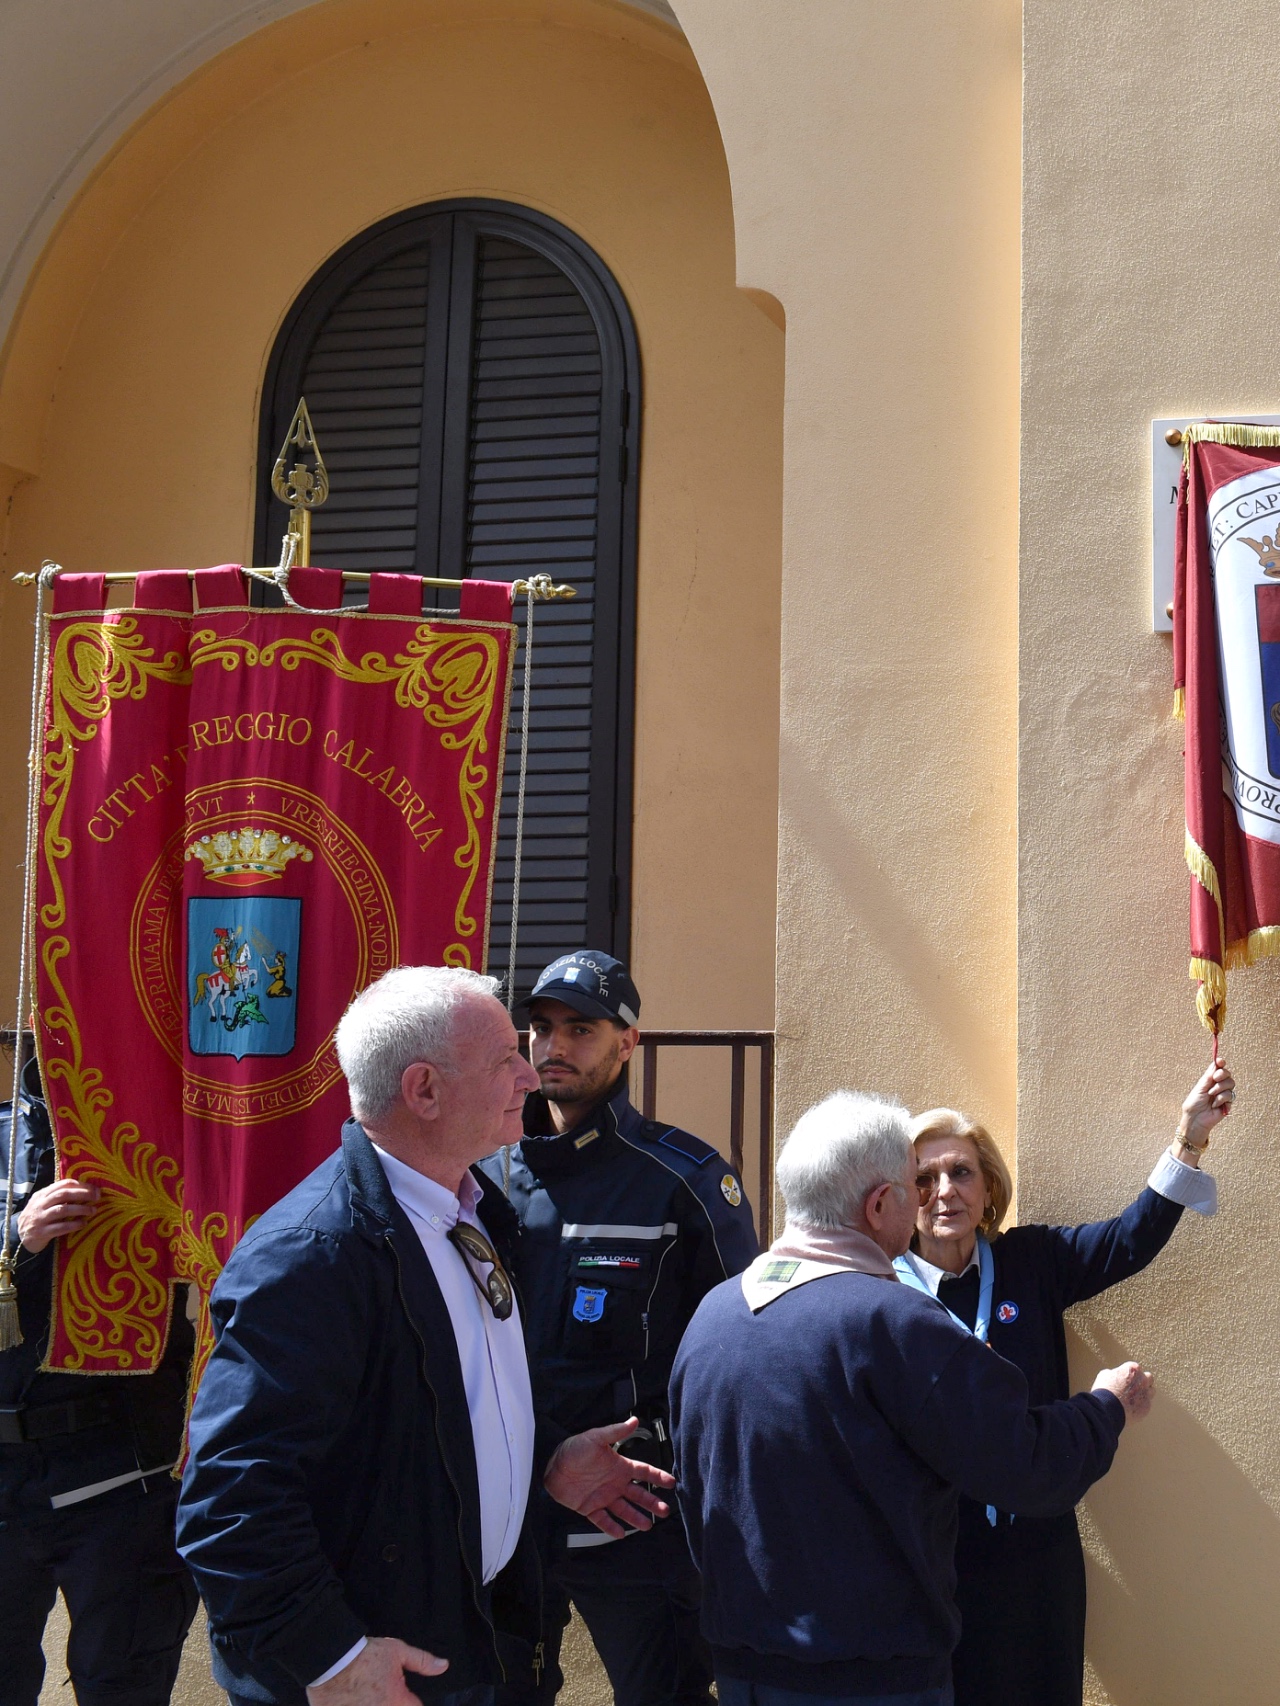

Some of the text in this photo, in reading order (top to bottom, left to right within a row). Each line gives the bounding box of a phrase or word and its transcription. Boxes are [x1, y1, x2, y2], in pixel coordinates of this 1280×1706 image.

[88, 711, 444, 853] CITTA' REGGIO CALABRIA
[185, 796, 223, 827] PVT
[538, 956, 609, 998] POLIZIA LOCALE
[609, 1255, 640, 1263] LOCALE
